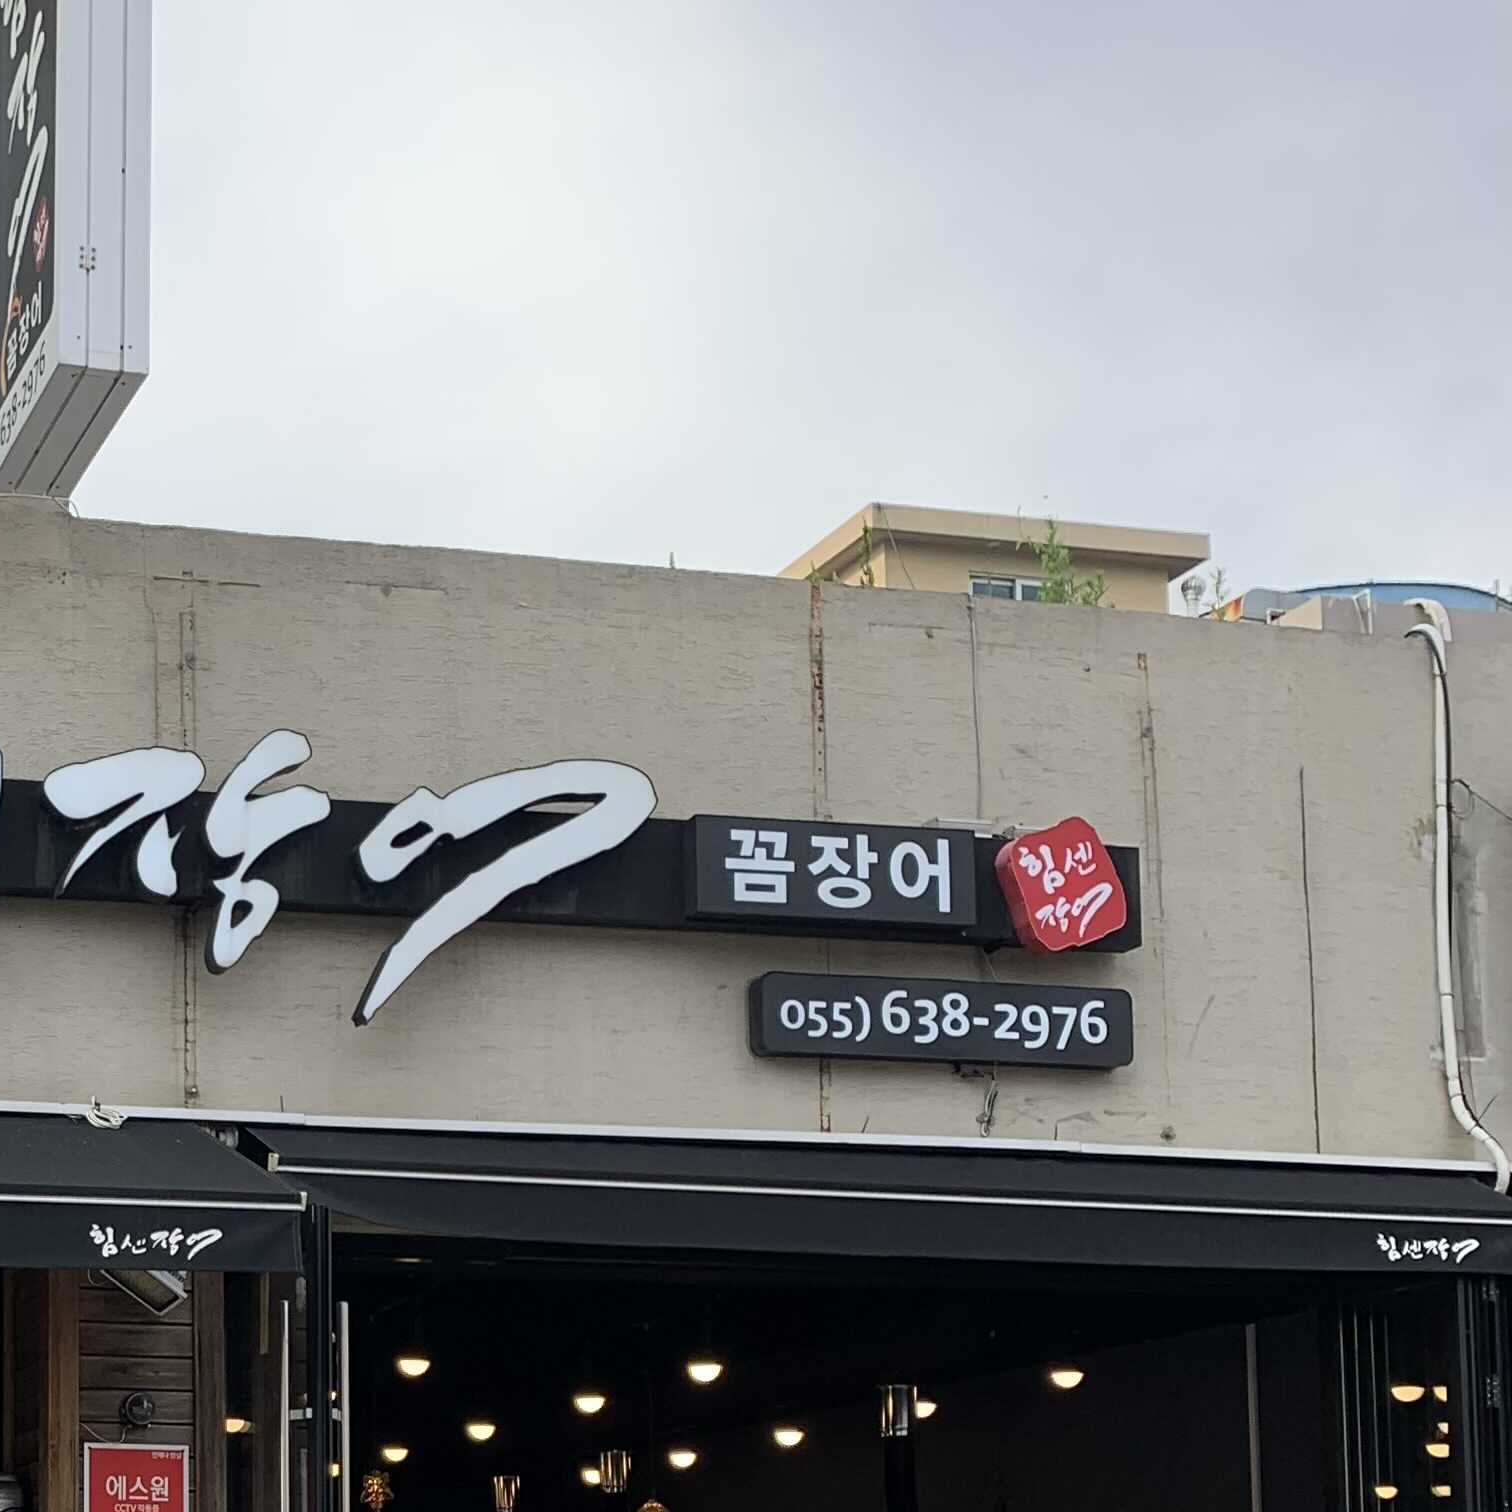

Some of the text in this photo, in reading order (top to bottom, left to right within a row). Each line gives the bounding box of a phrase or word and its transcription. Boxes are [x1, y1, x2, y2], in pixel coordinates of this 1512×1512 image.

[0, 340, 46, 446] 638-2976
[724, 827, 951, 914] 꼼장어
[105, 1474, 170, 1502] 에스원
[114, 1503, 137, 1512] CCTV
